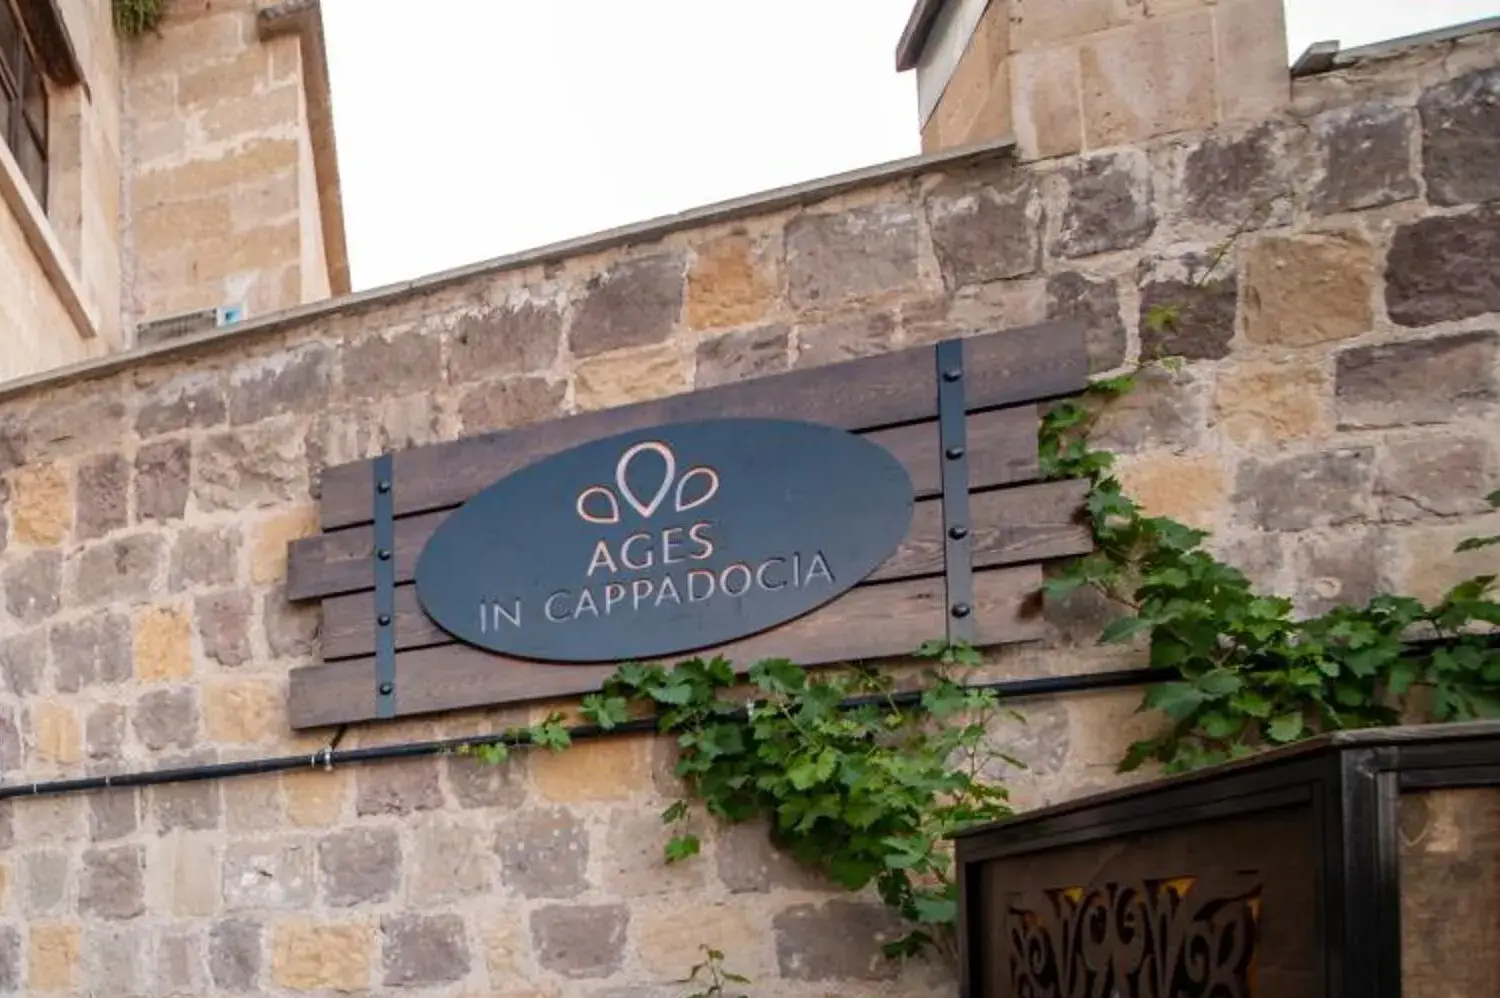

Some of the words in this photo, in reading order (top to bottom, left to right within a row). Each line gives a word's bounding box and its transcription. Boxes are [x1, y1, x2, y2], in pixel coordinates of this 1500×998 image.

[587, 523, 713, 576] AGES
[479, 599, 522, 633] IN
[545, 551, 835, 622] CAPPADOCIA
